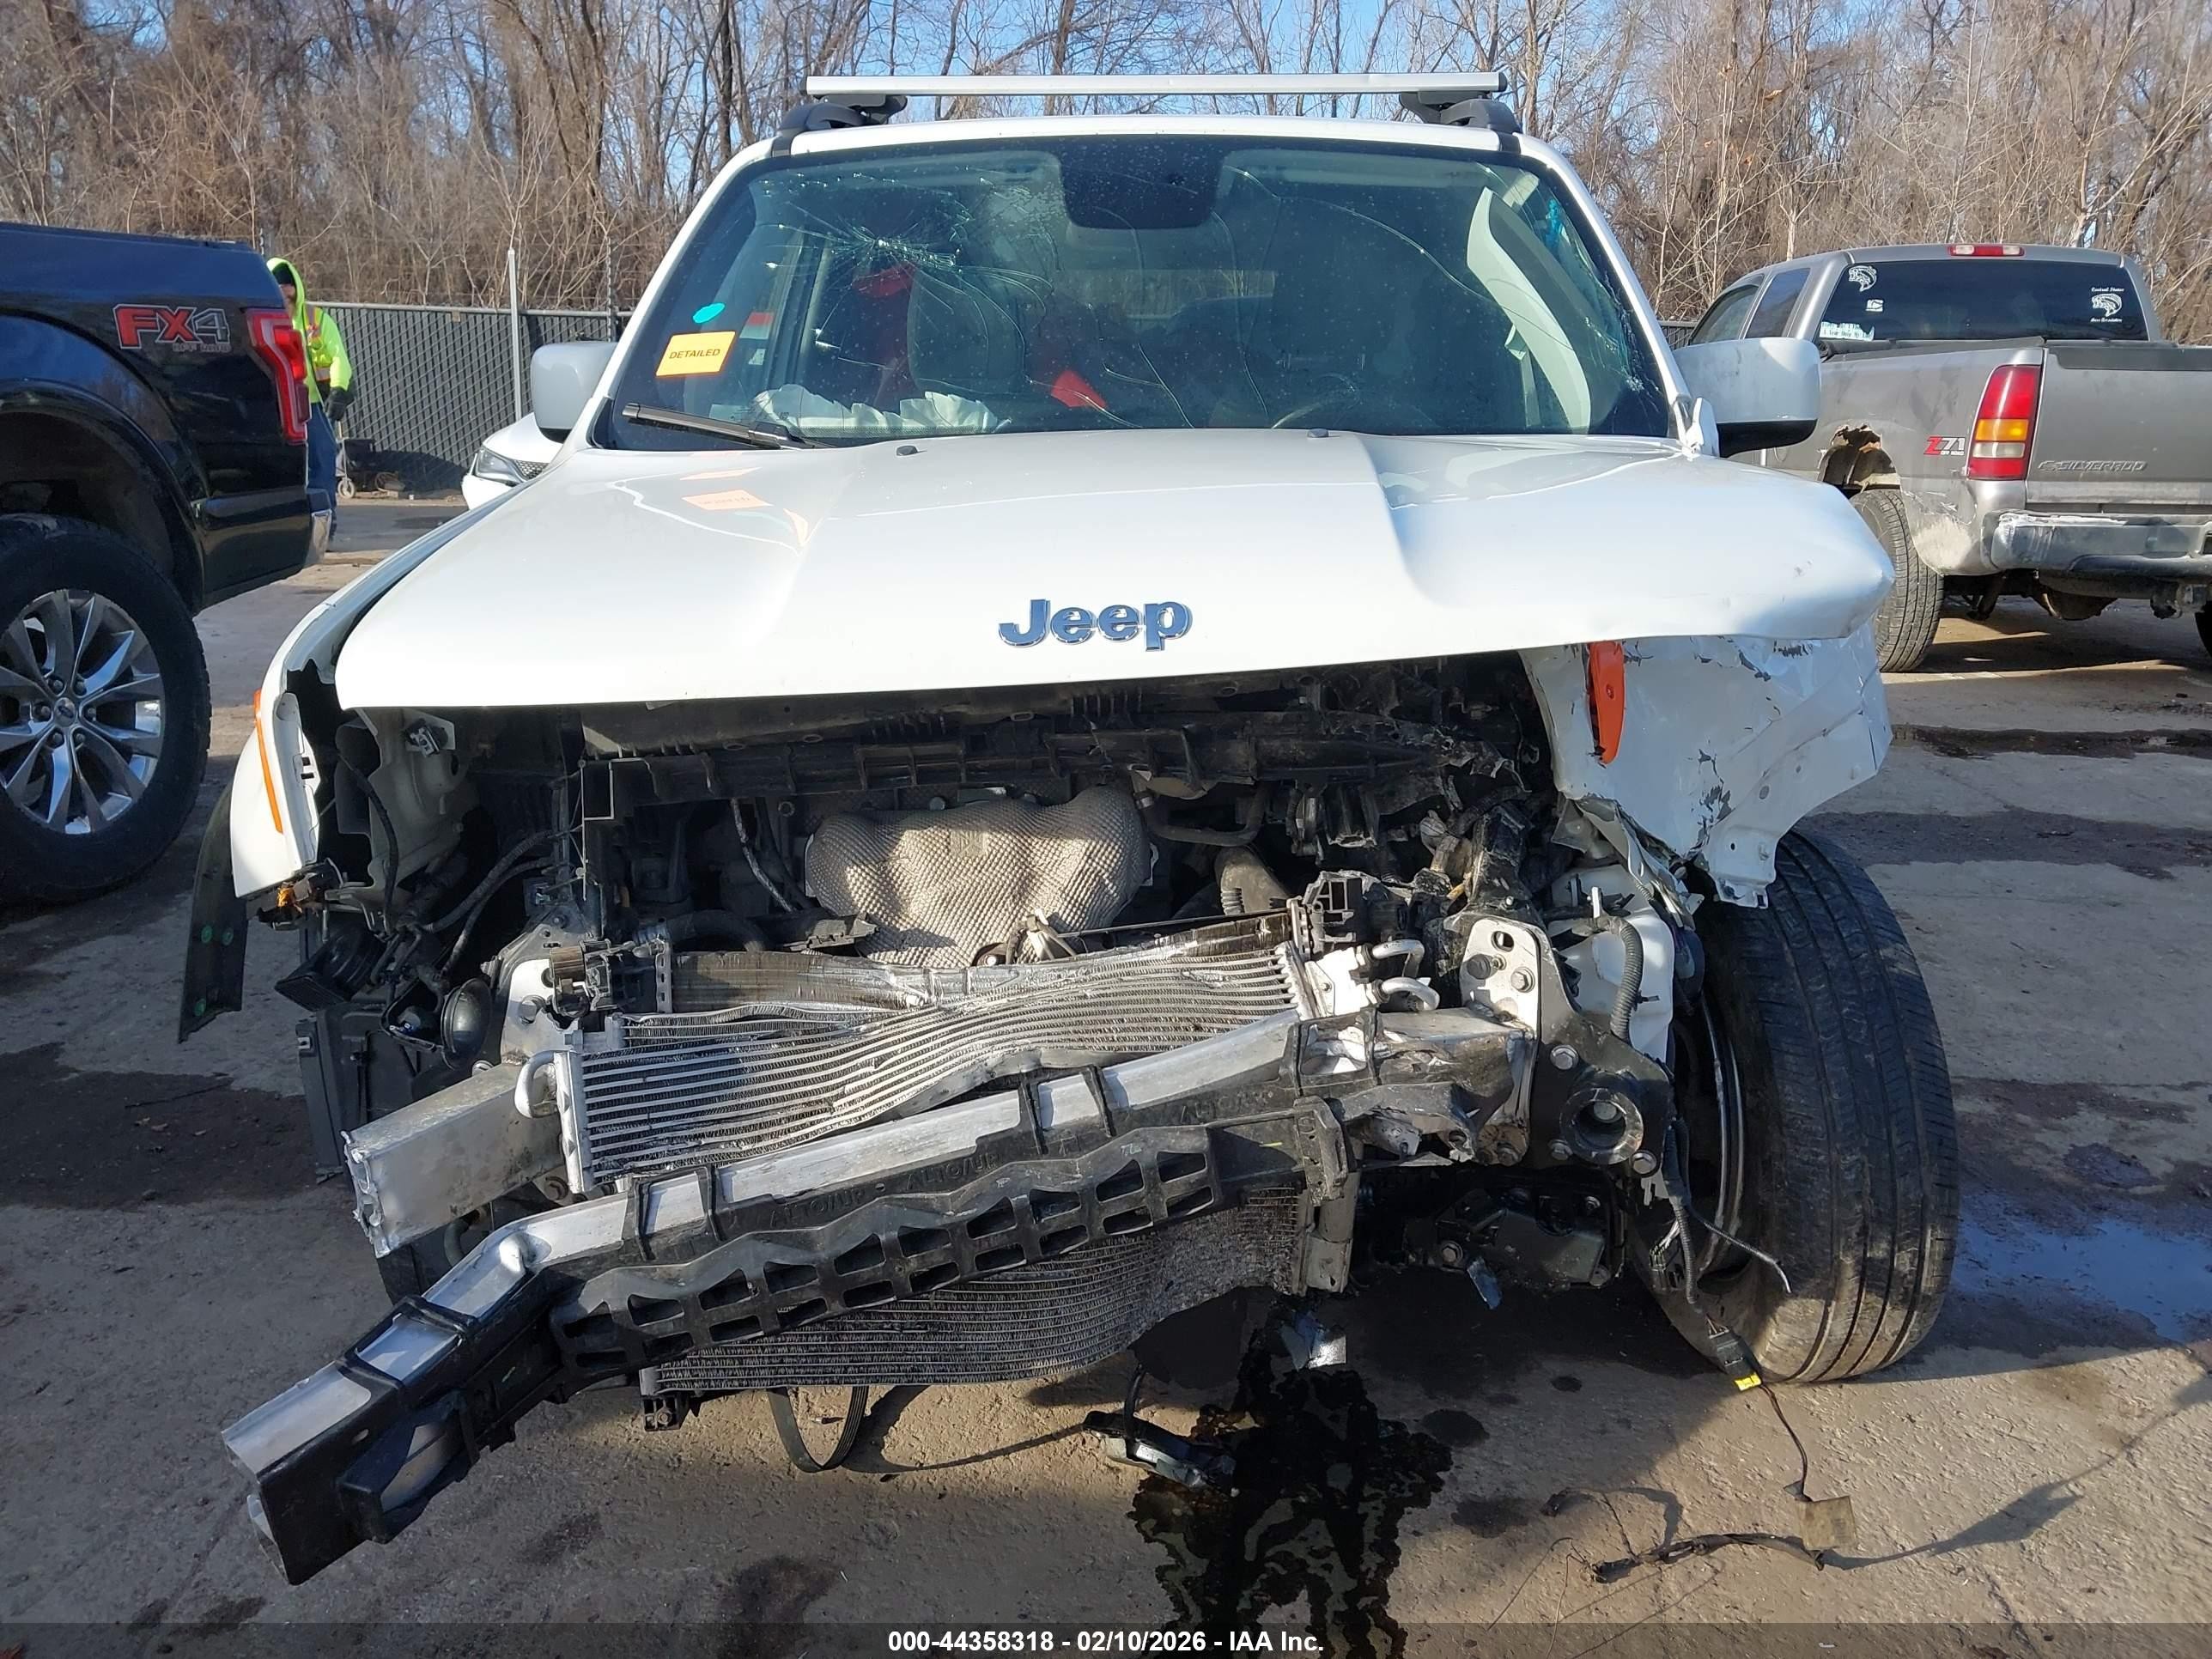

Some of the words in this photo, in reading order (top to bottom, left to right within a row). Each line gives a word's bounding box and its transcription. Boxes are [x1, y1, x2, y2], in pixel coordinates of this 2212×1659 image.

[113, 303, 231, 349] FX4
[669, 349, 721, 359] DETAILED
[1923, 436, 1966, 455] Z71
[2057, 459, 2147, 472] SILVERADO
[998, 599, 1194, 653] Jeep
